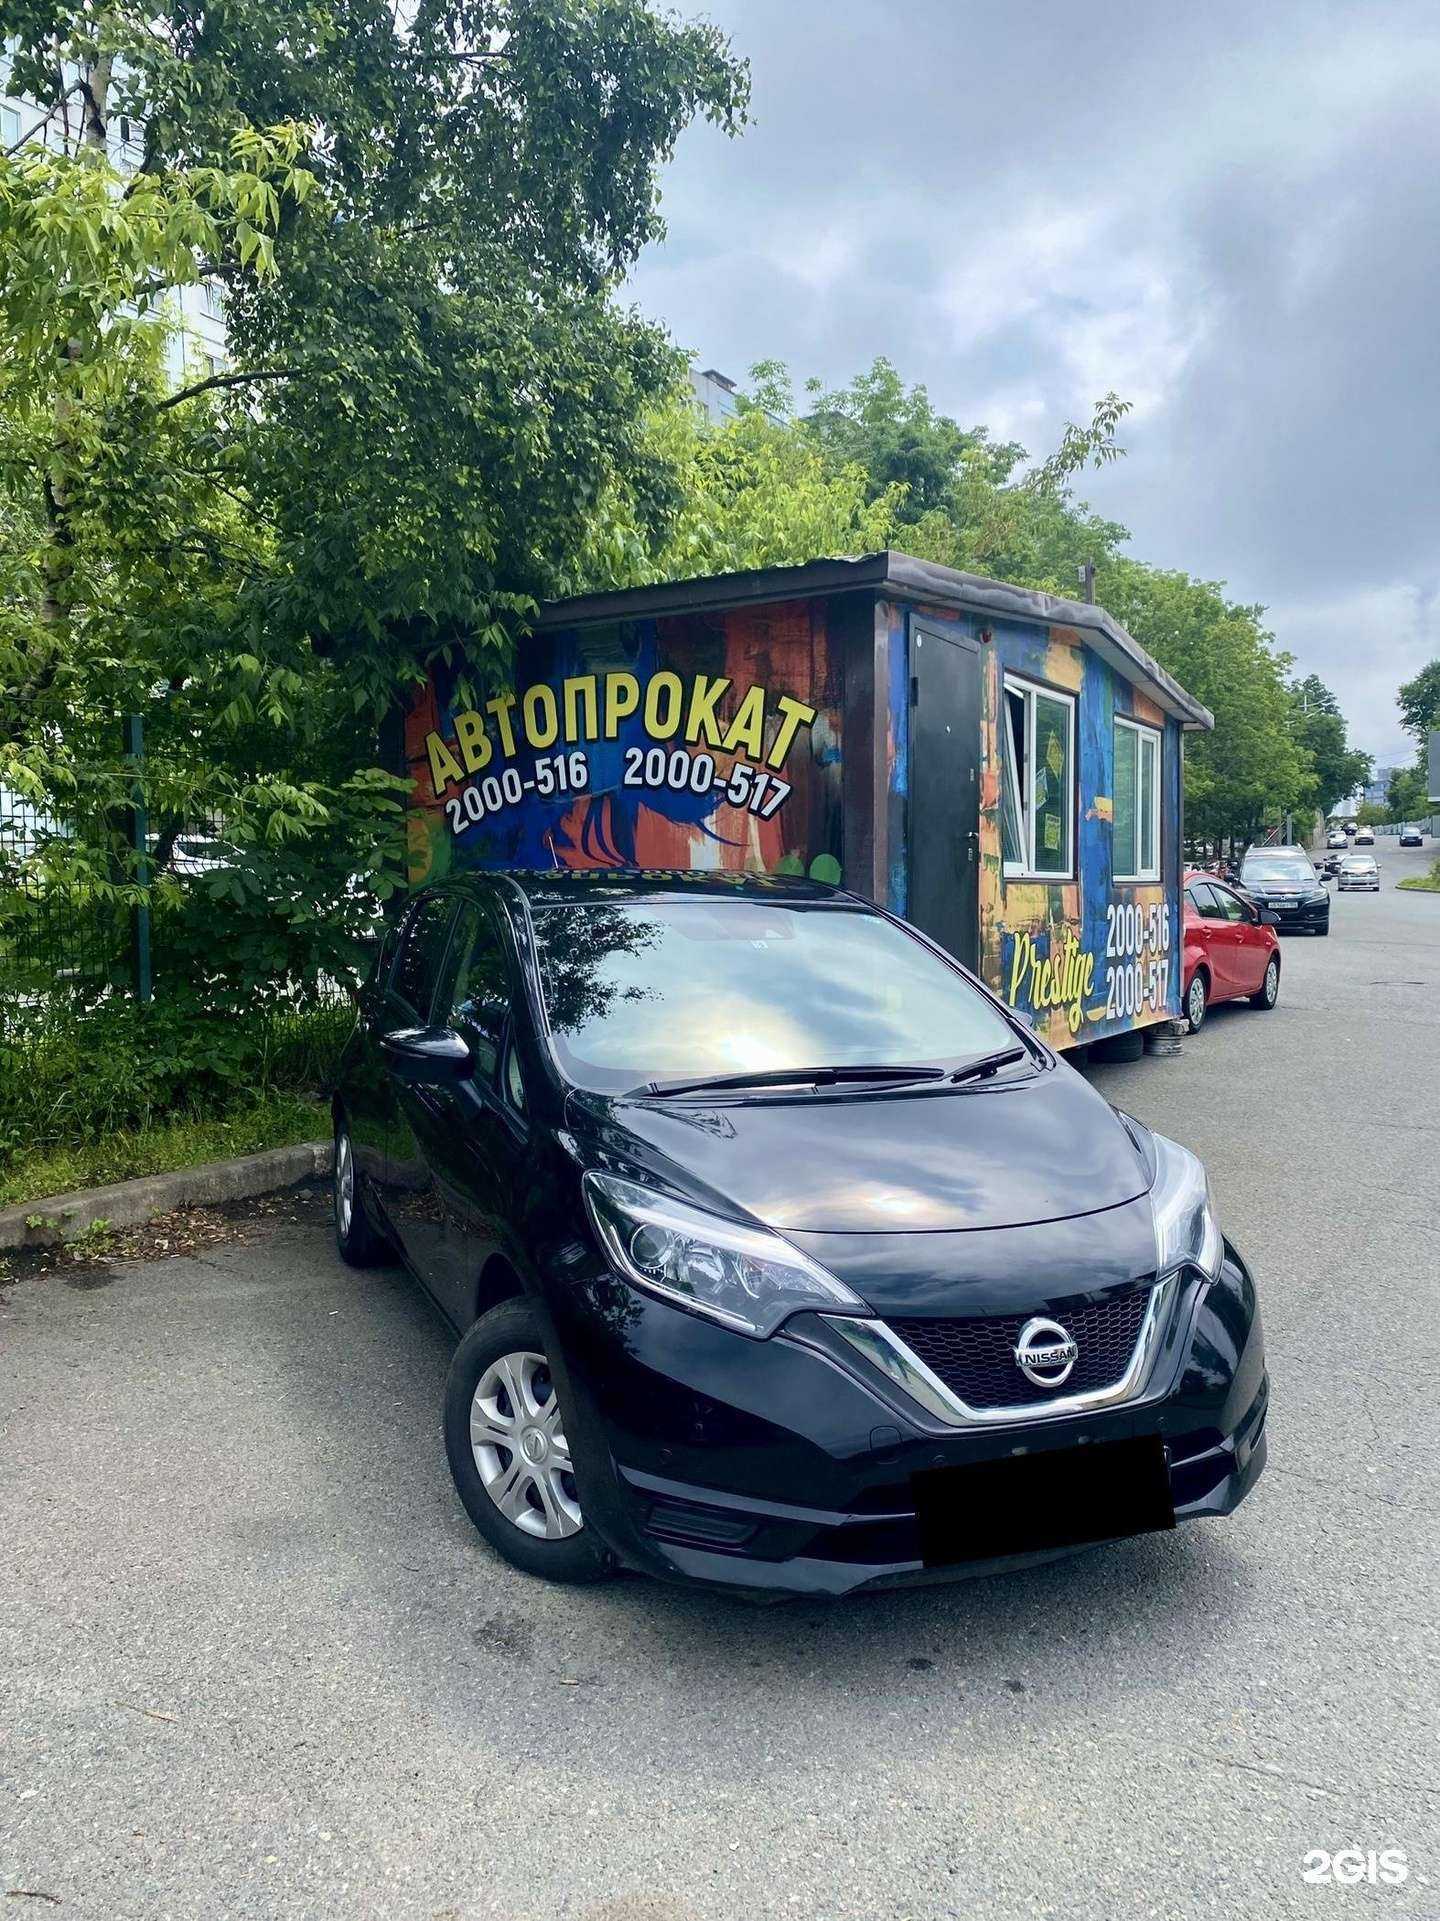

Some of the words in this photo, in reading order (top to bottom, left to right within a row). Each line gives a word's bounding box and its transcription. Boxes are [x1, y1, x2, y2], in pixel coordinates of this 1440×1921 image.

[426, 671, 817, 795] АВТОПРОКАТ
[445, 751, 589, 834] 2000-516
[624, 747, 791, 817] 2000-517
[1106, 903, 1170, 958] 2000-516
[1008, 927, 1094, 1033] Prestige
[1106, 959, 1169, 1020] 2000-517
[1024, 1345, 1075, 1364] NISSAN
